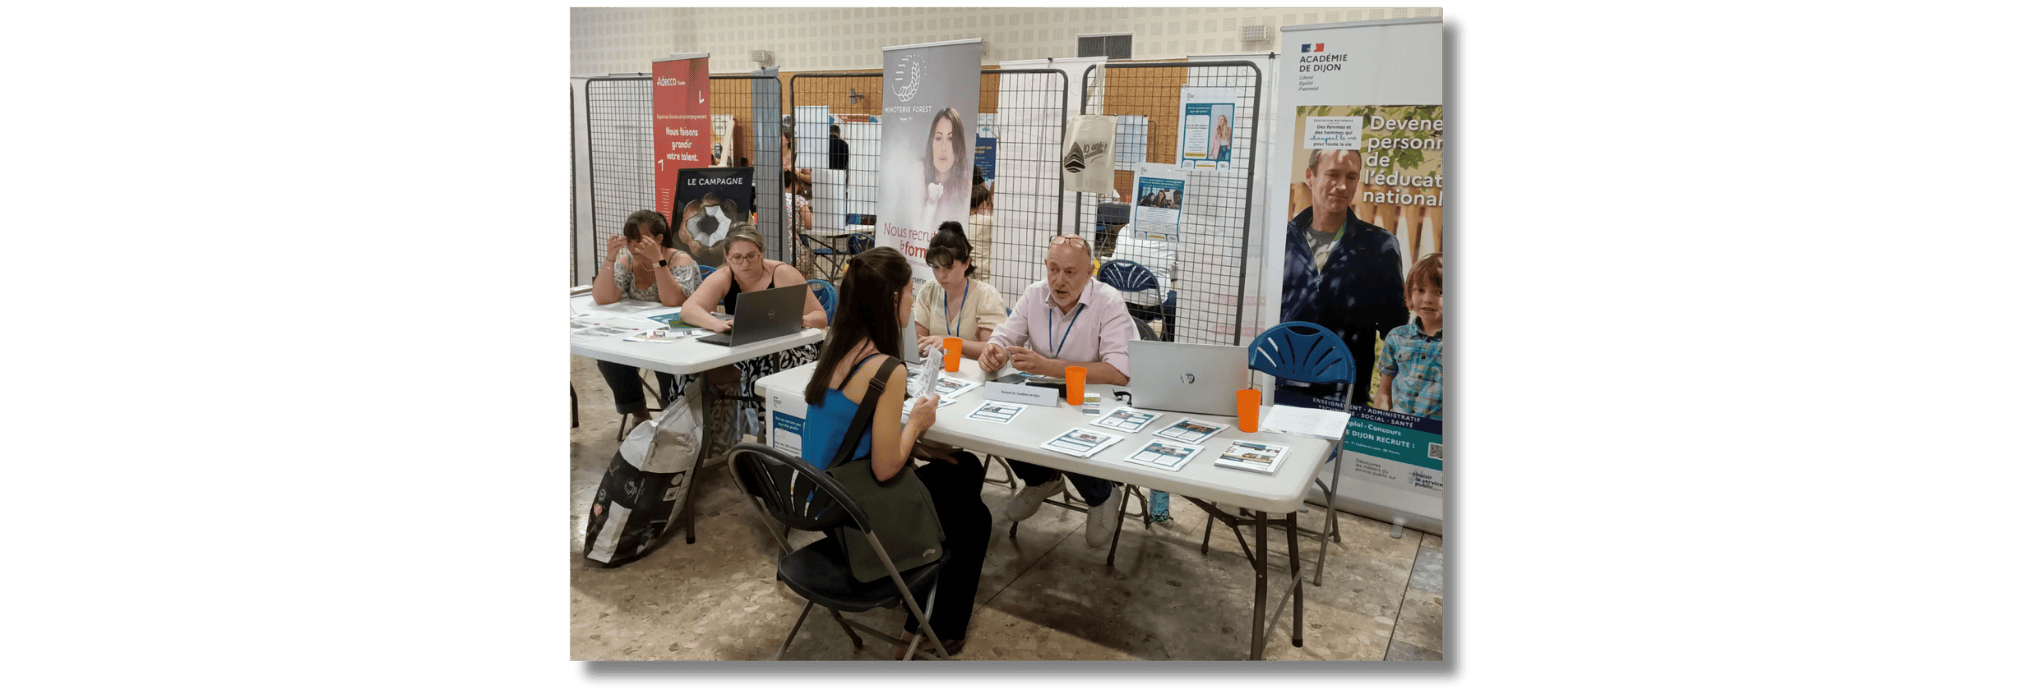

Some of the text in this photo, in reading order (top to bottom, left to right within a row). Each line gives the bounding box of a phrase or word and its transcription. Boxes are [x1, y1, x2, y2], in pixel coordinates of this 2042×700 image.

[1299, 53, 1348, 63] ACADÉMIE
[1313, 64, 1341, 73] DIJON
[657, 76, 676, 86] Adecco
[666, 126, 698, 136] Nous faisons
[672, 139, 692, 150] grandir
[1366, 152, 1390, 167] de
[1363, 189, 1443, 206] national
[884, 222, 907, 238] Nous
[1361, 413, 1385, 423] SOCIAL
[1391, 419, 1414, 428] SANTÉ
[1368, 408, 1420, 423] ADMINISTRATIF
[1368, 424, 1401, 436] Concours
[1352, 430, 1374, 440] DIJON
[1376, 436, 1410, 448] RECRUTE
[1356, 458, 1381, 468] Découvrez
